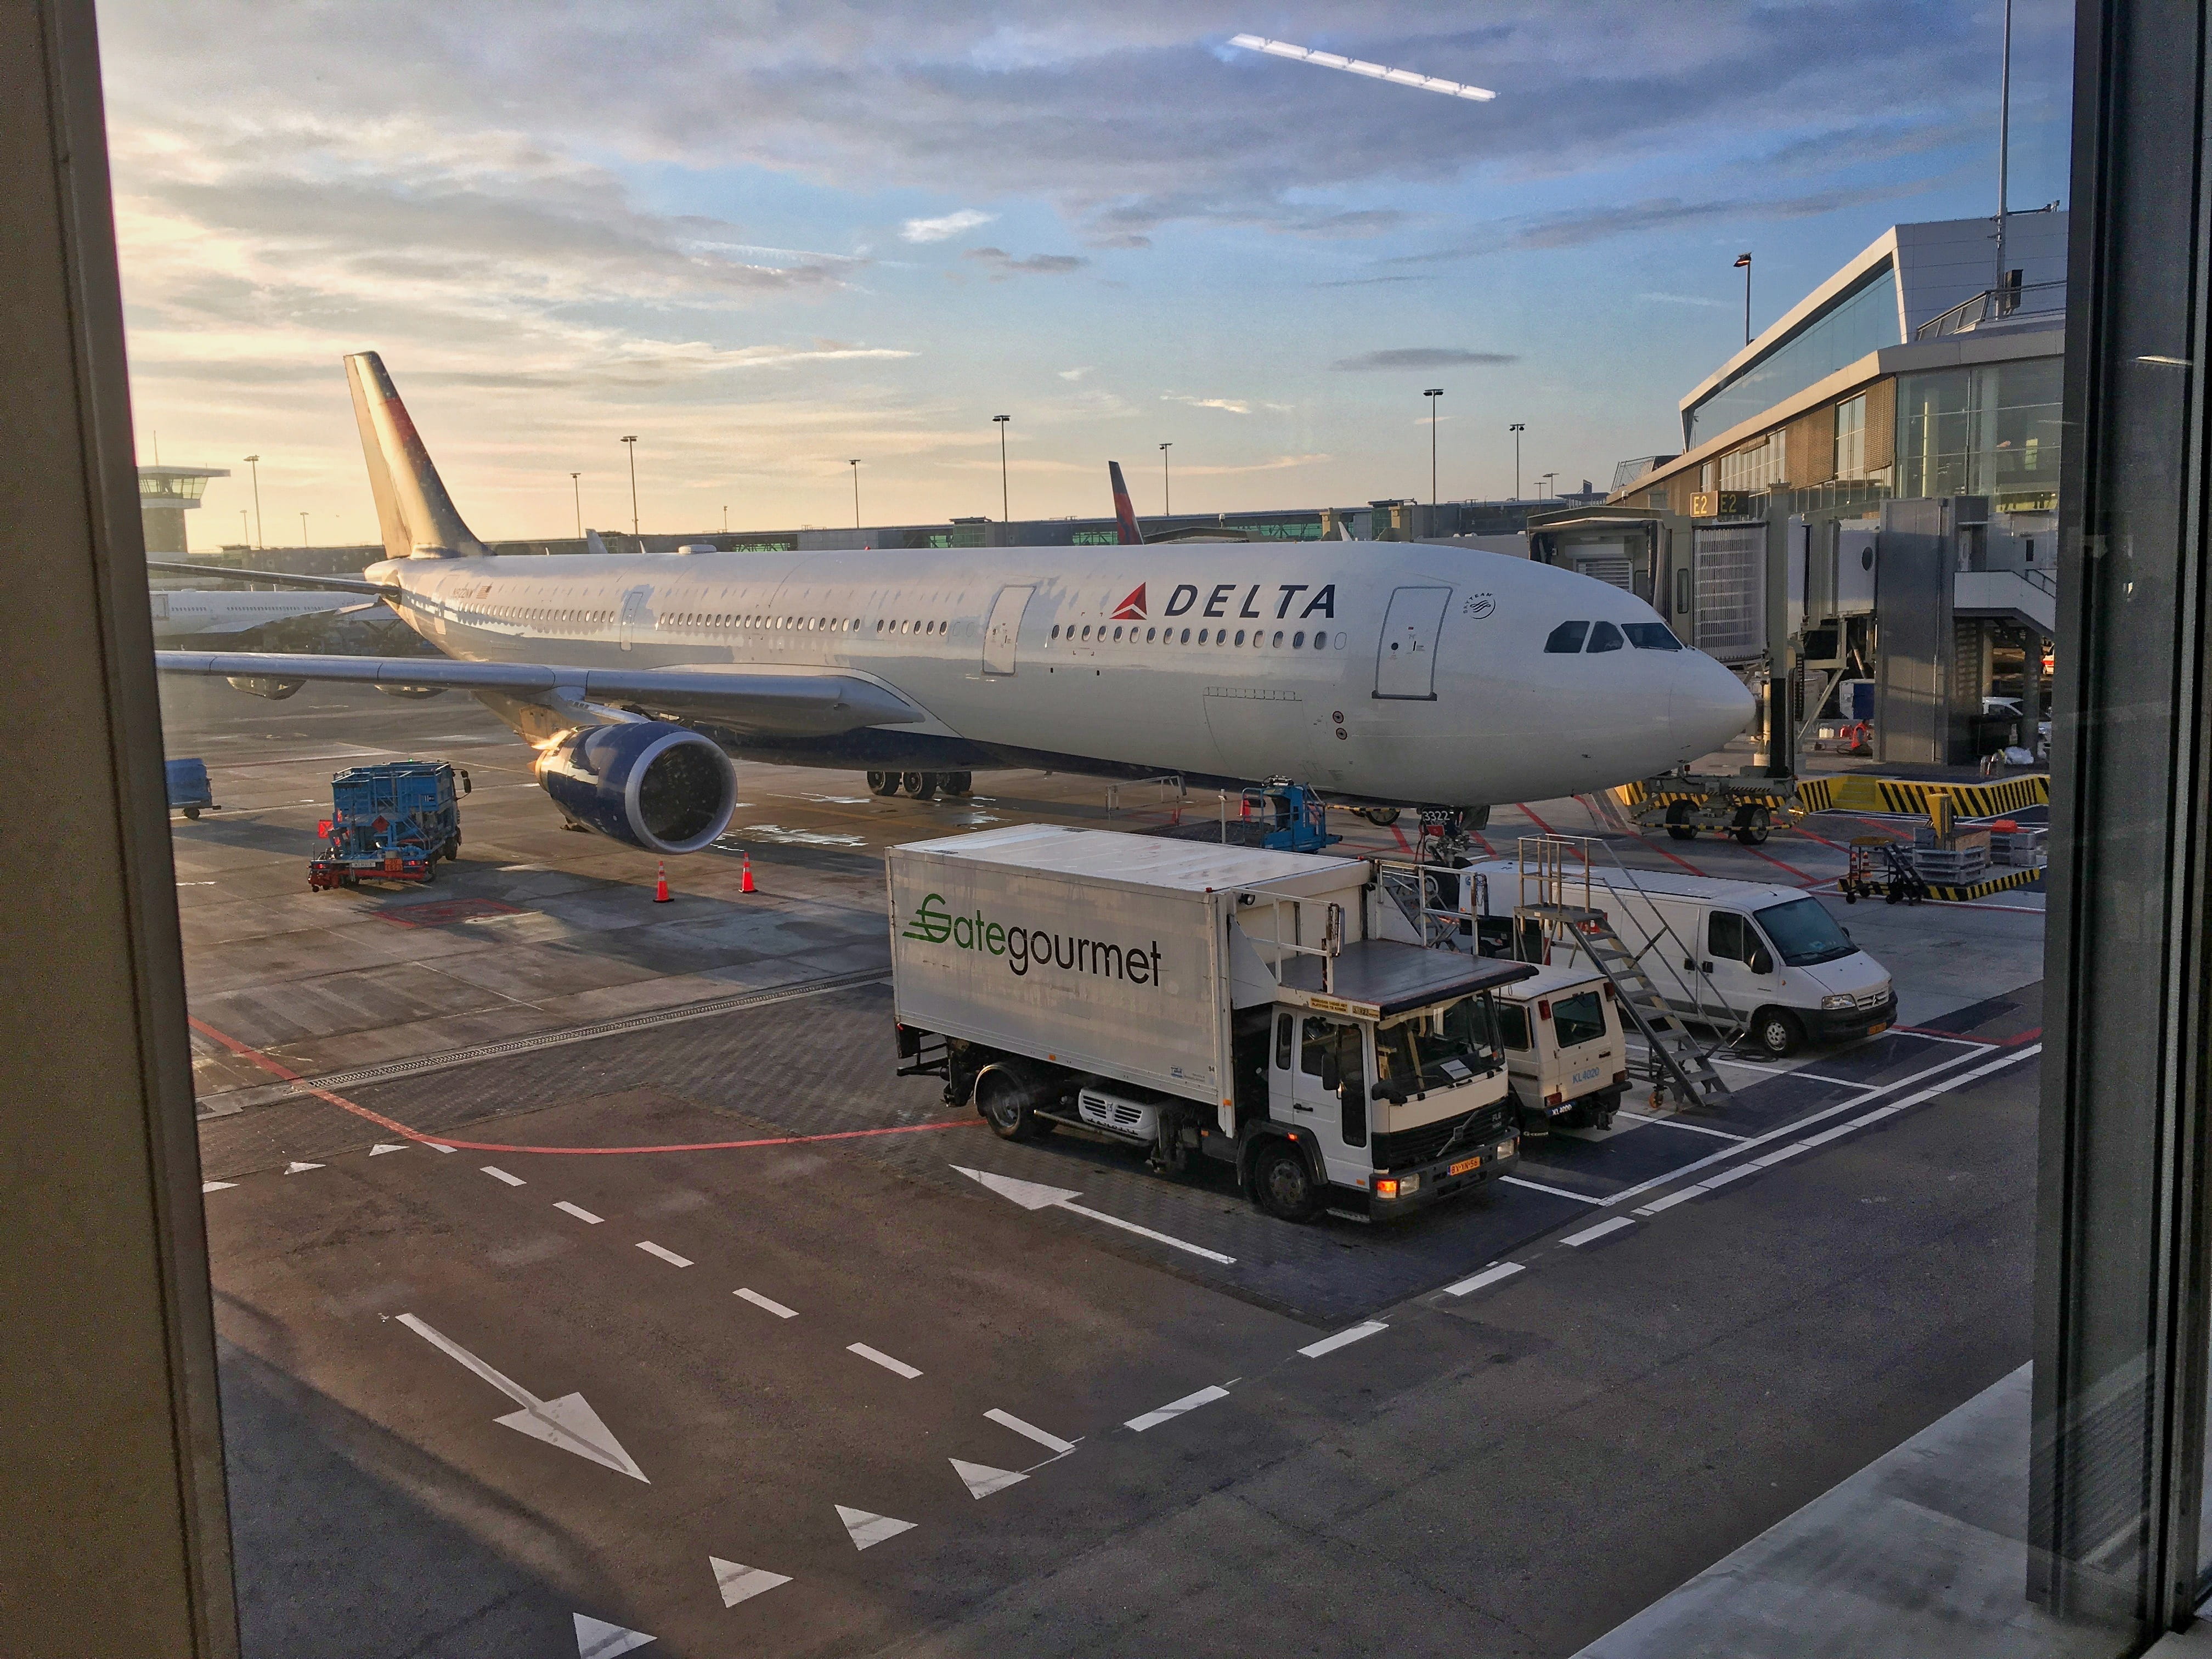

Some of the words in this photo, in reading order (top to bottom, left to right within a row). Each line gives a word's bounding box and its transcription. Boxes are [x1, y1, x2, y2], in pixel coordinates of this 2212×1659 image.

[1694, 495, 1707, 515] E2
[1720, 494, 1737, 513] E2
[1164, 584, 1336, 619] DELTA
[1463, 592, 1493, 614] SKYTEAM
[1422, 811, 1450, 821] 3322
